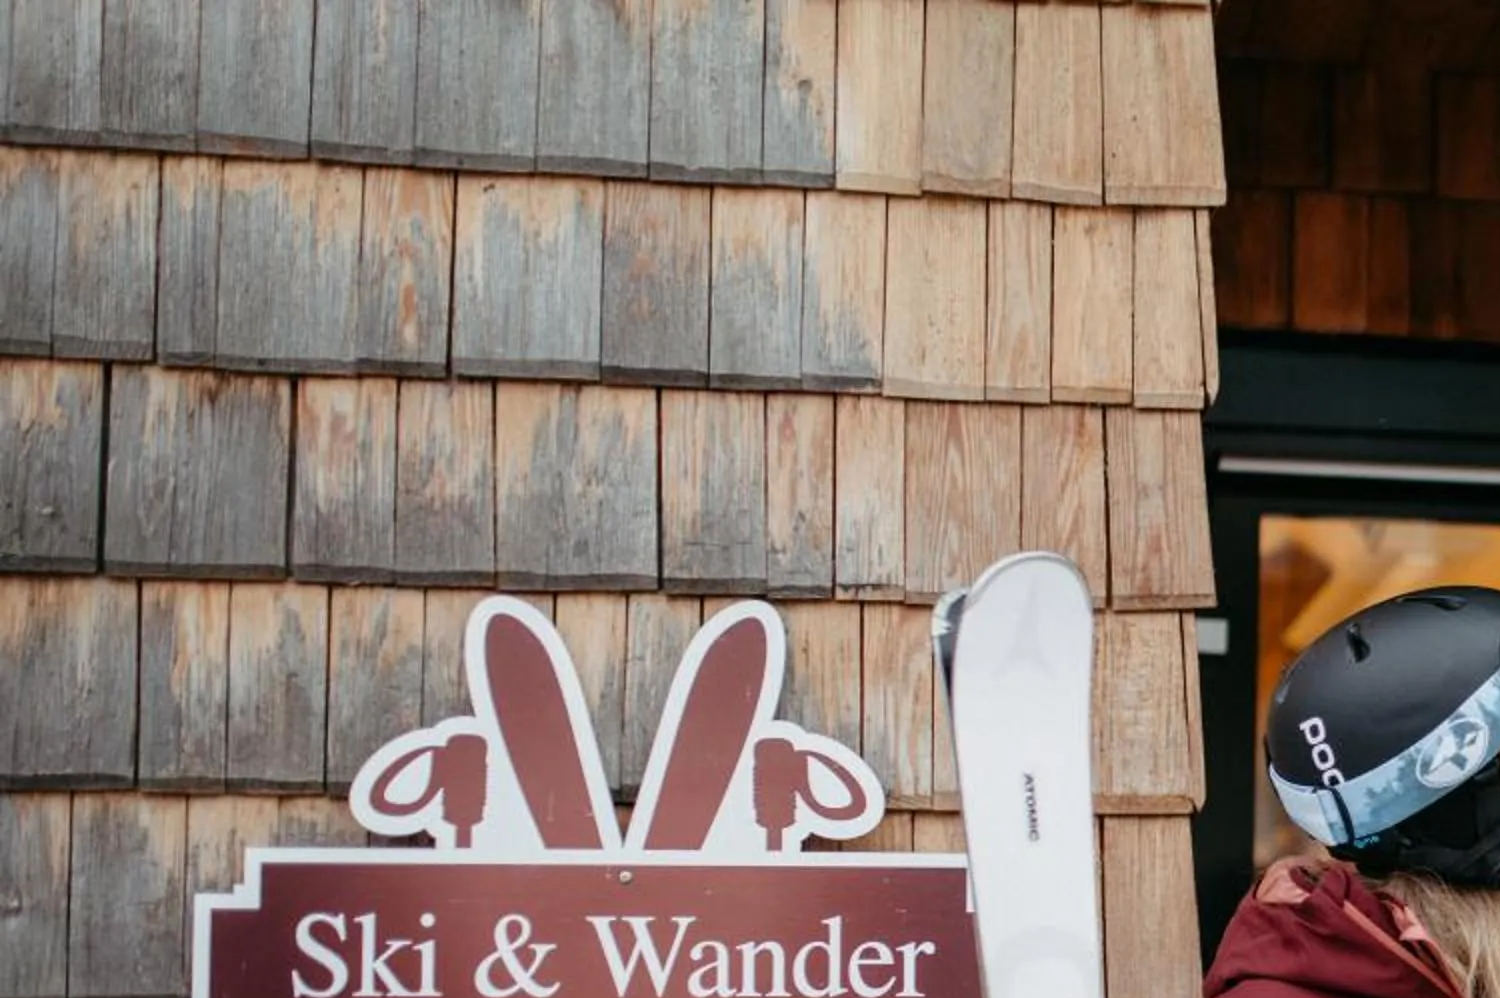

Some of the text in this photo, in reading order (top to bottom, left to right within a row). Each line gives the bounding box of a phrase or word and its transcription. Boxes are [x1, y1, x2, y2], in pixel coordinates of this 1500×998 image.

[291, 911, 935, 998] Ski & Wander
